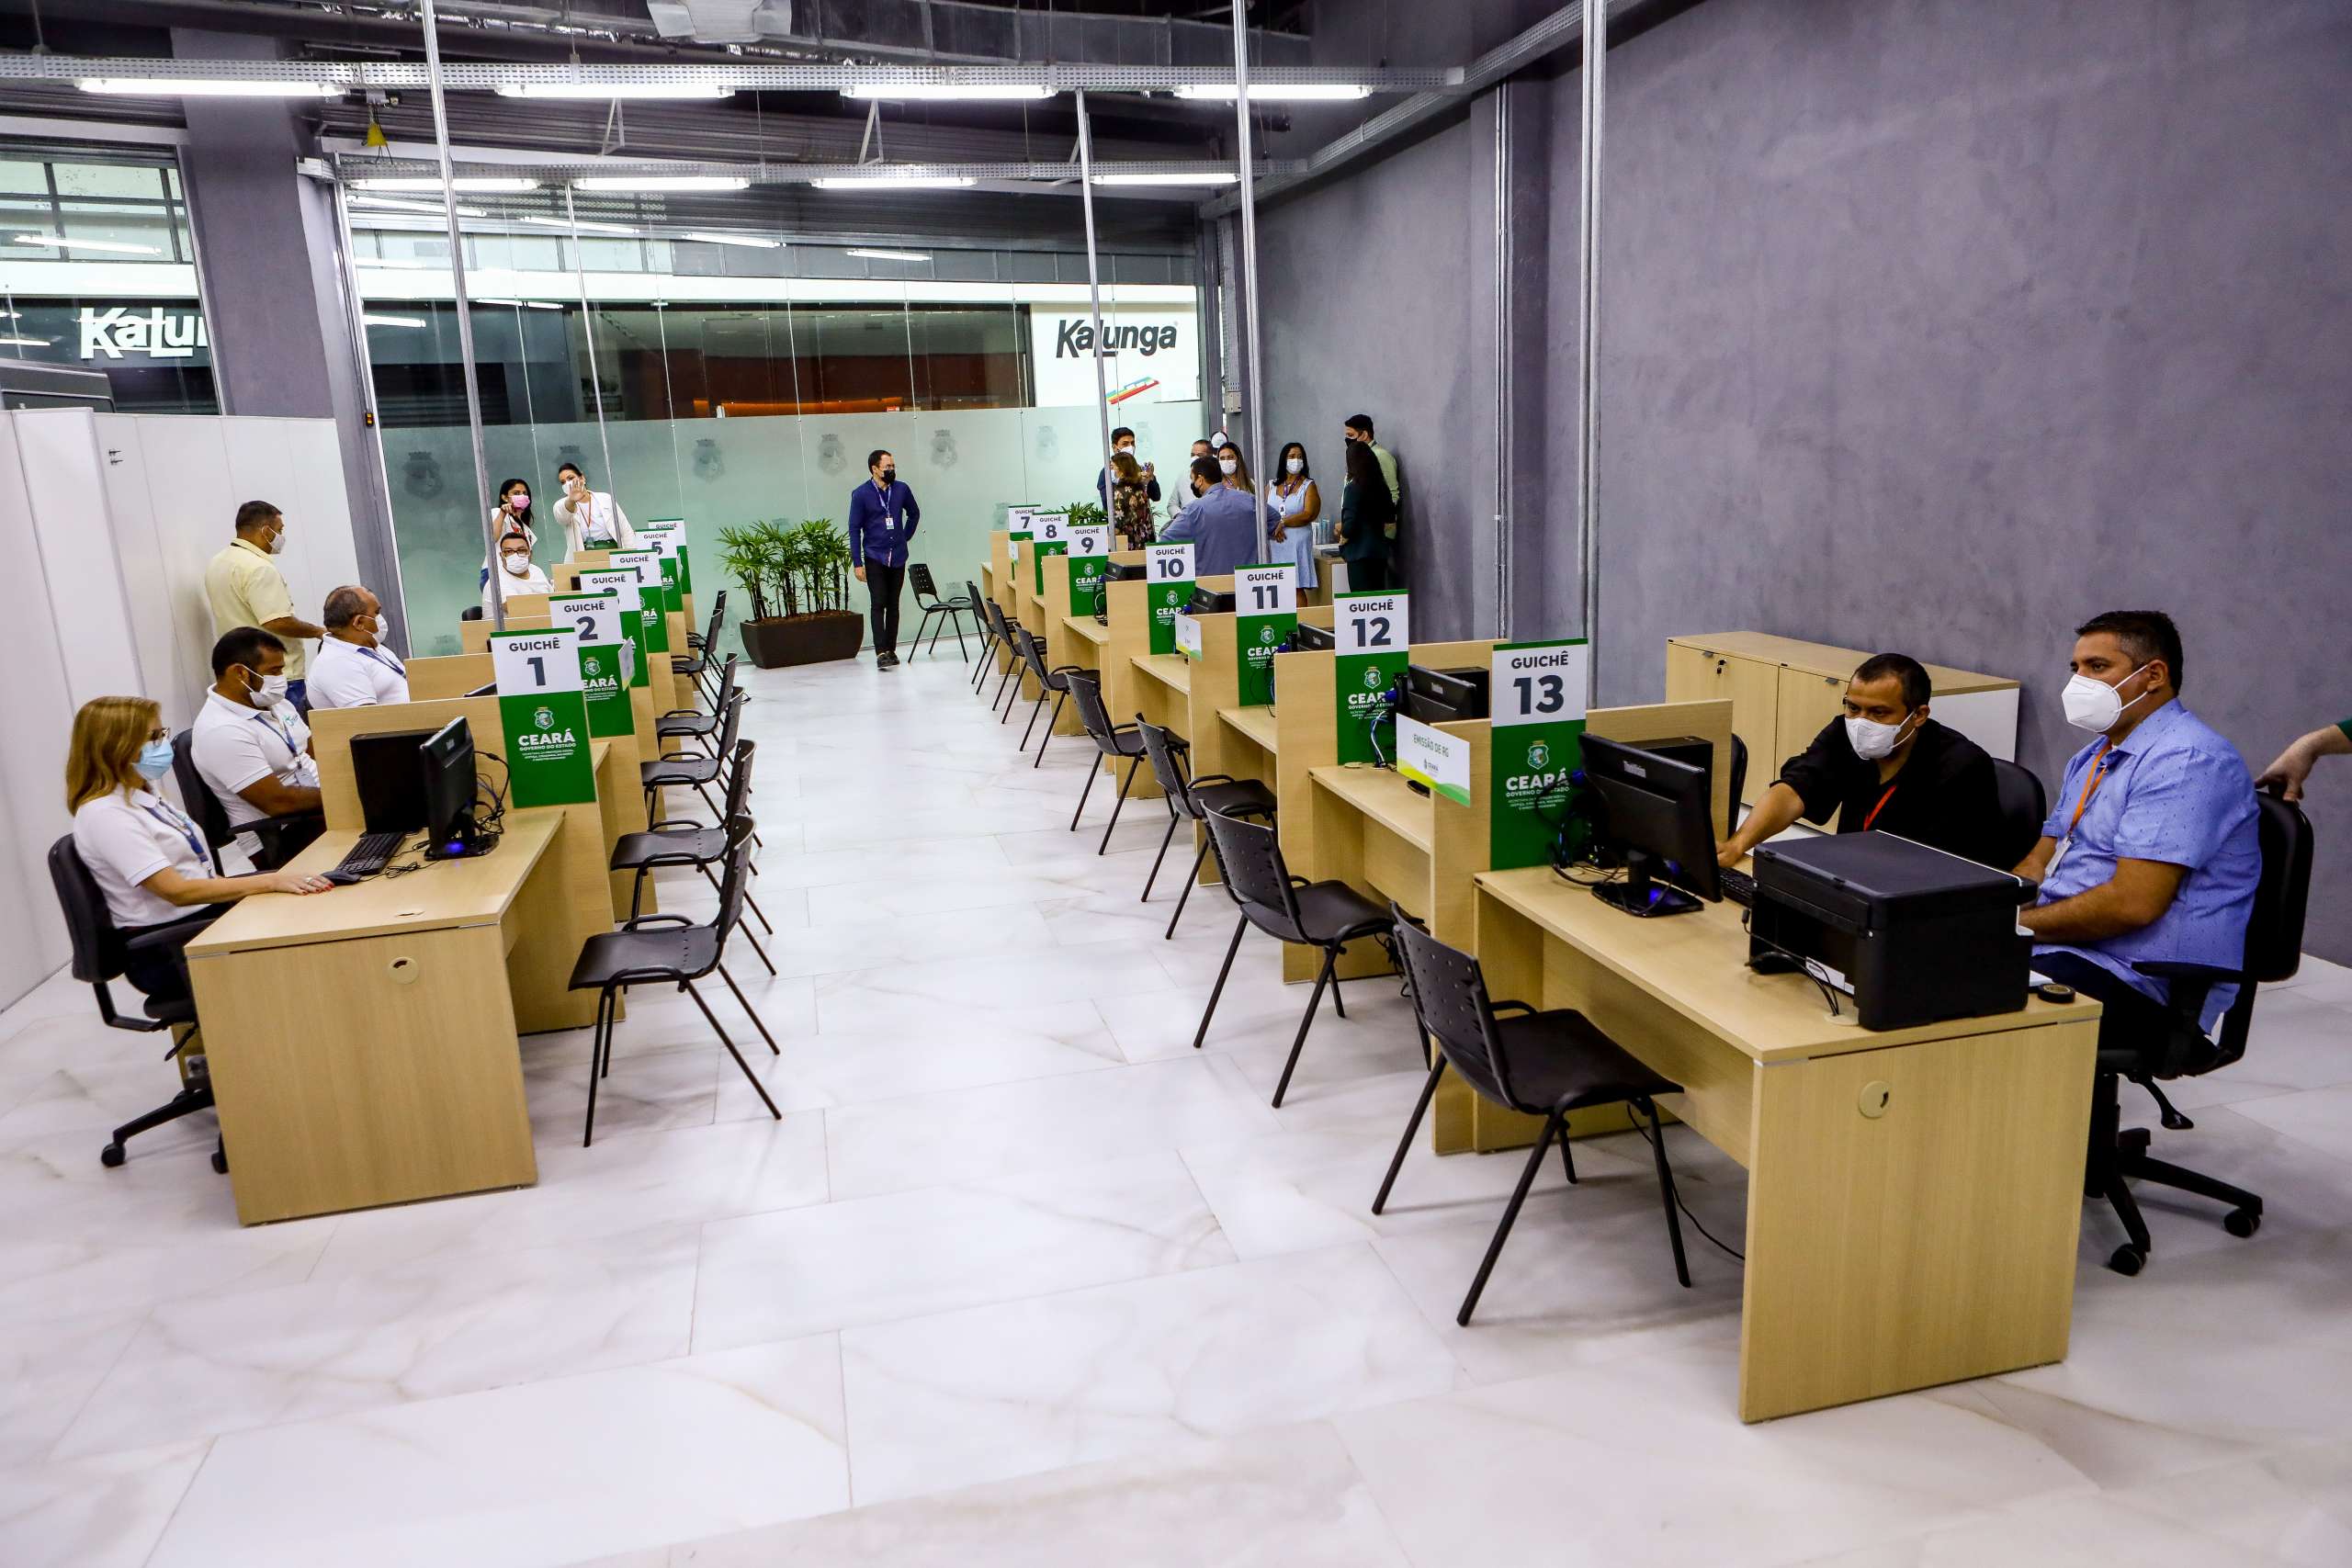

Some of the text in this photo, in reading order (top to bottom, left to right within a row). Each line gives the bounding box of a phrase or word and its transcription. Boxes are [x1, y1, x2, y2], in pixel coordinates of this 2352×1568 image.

[1021, 516, 1030, 529] 7
[1046, 525, 1057, 539] 8
[651, 541, 663, 556] 5
[1080, 536, 1094, 554] 9
[1155, 547, 1185, 556] GUICHÊ
[619, 555, 650, 563] GUICHÊ
[1157, 558, 1184, 579] 10
[1247, 570, 1284, 581] GUICHÊ
[592, 574, 627, 584] GUICHÊ
[1251, 584, 1279, 610] 11
[563, 601, 605, 613] GUICHÊ
[1349, 599, 1394, 613] GUICHÊ
[576, 616, 598, 641] 2
[1351, 616, 1391, 648] 12
[509, 637, 560, 652] GUICHÊ
[1510, 650, 1569, 670] GUICHÊ
[526, 657, 546, 686] 1
[582, 674, 617, 688] EARÁ
[1348, 690, 1387, 705] CEAR
[1513, 674, 1565, 716] 13
[518, 728, 576, 746] CEARÁ
